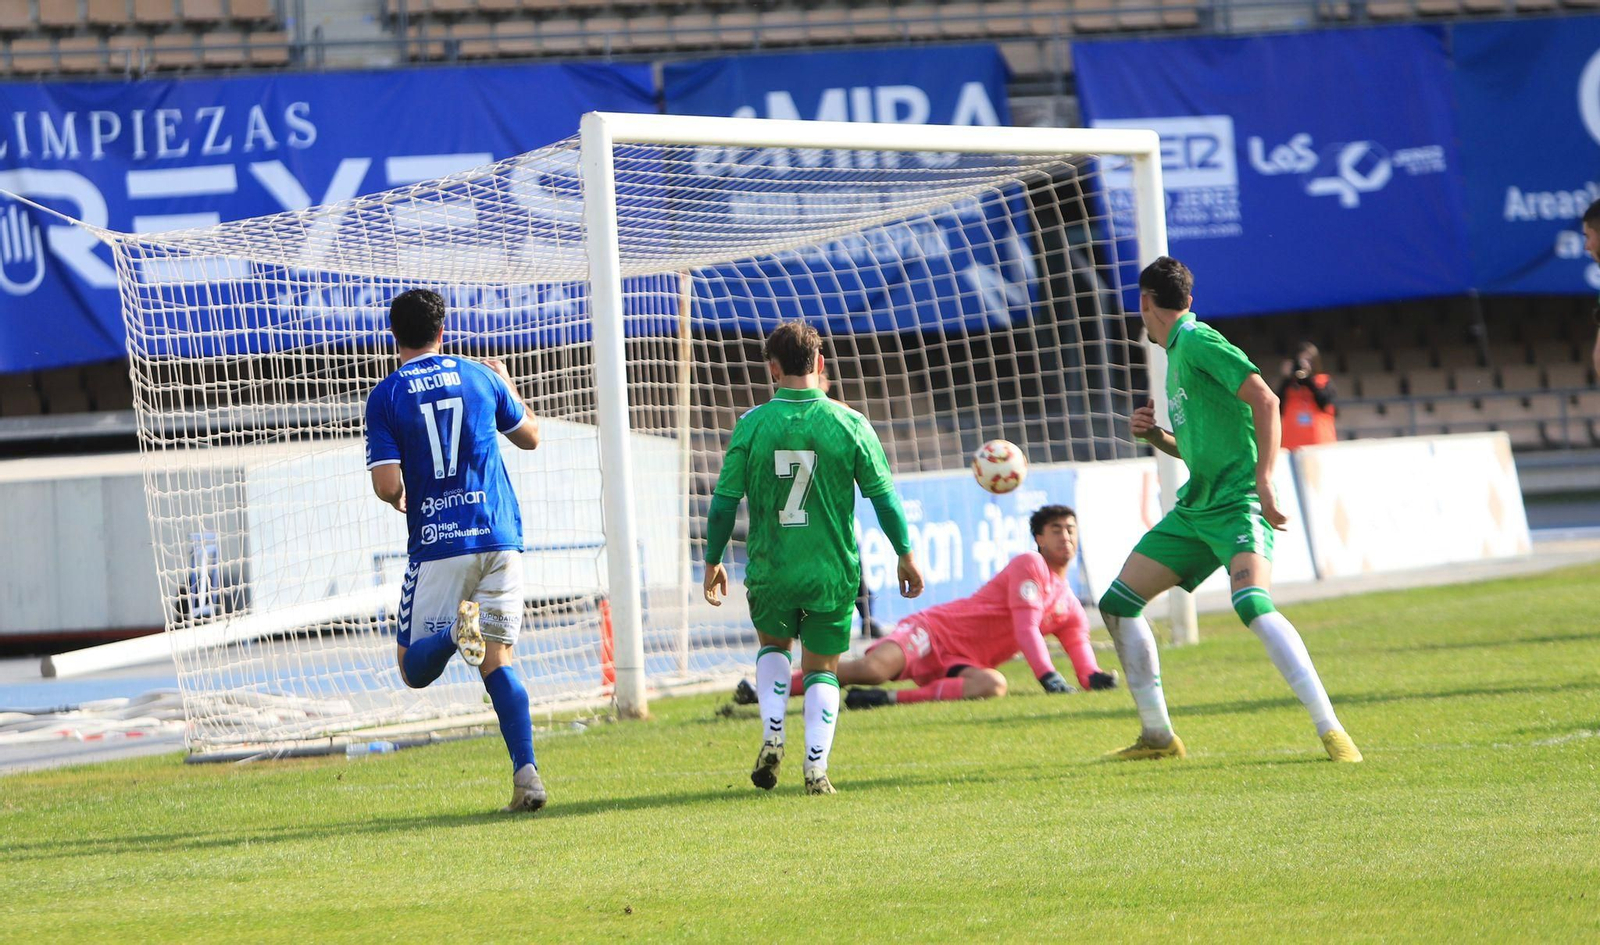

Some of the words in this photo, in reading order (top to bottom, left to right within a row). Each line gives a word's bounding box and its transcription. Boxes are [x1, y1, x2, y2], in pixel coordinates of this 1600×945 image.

[0, 101, 318, 161] IMPIEZAS
[407, 371, 462, 394] JACOBO
[420, 396, 464, 480] 17
[774, 450, 818, 527] 7
[421, 490, 487, 518] Beiman
[438, 521, 459, 532] High
[438, 527, 491, 540] ProNutrition
